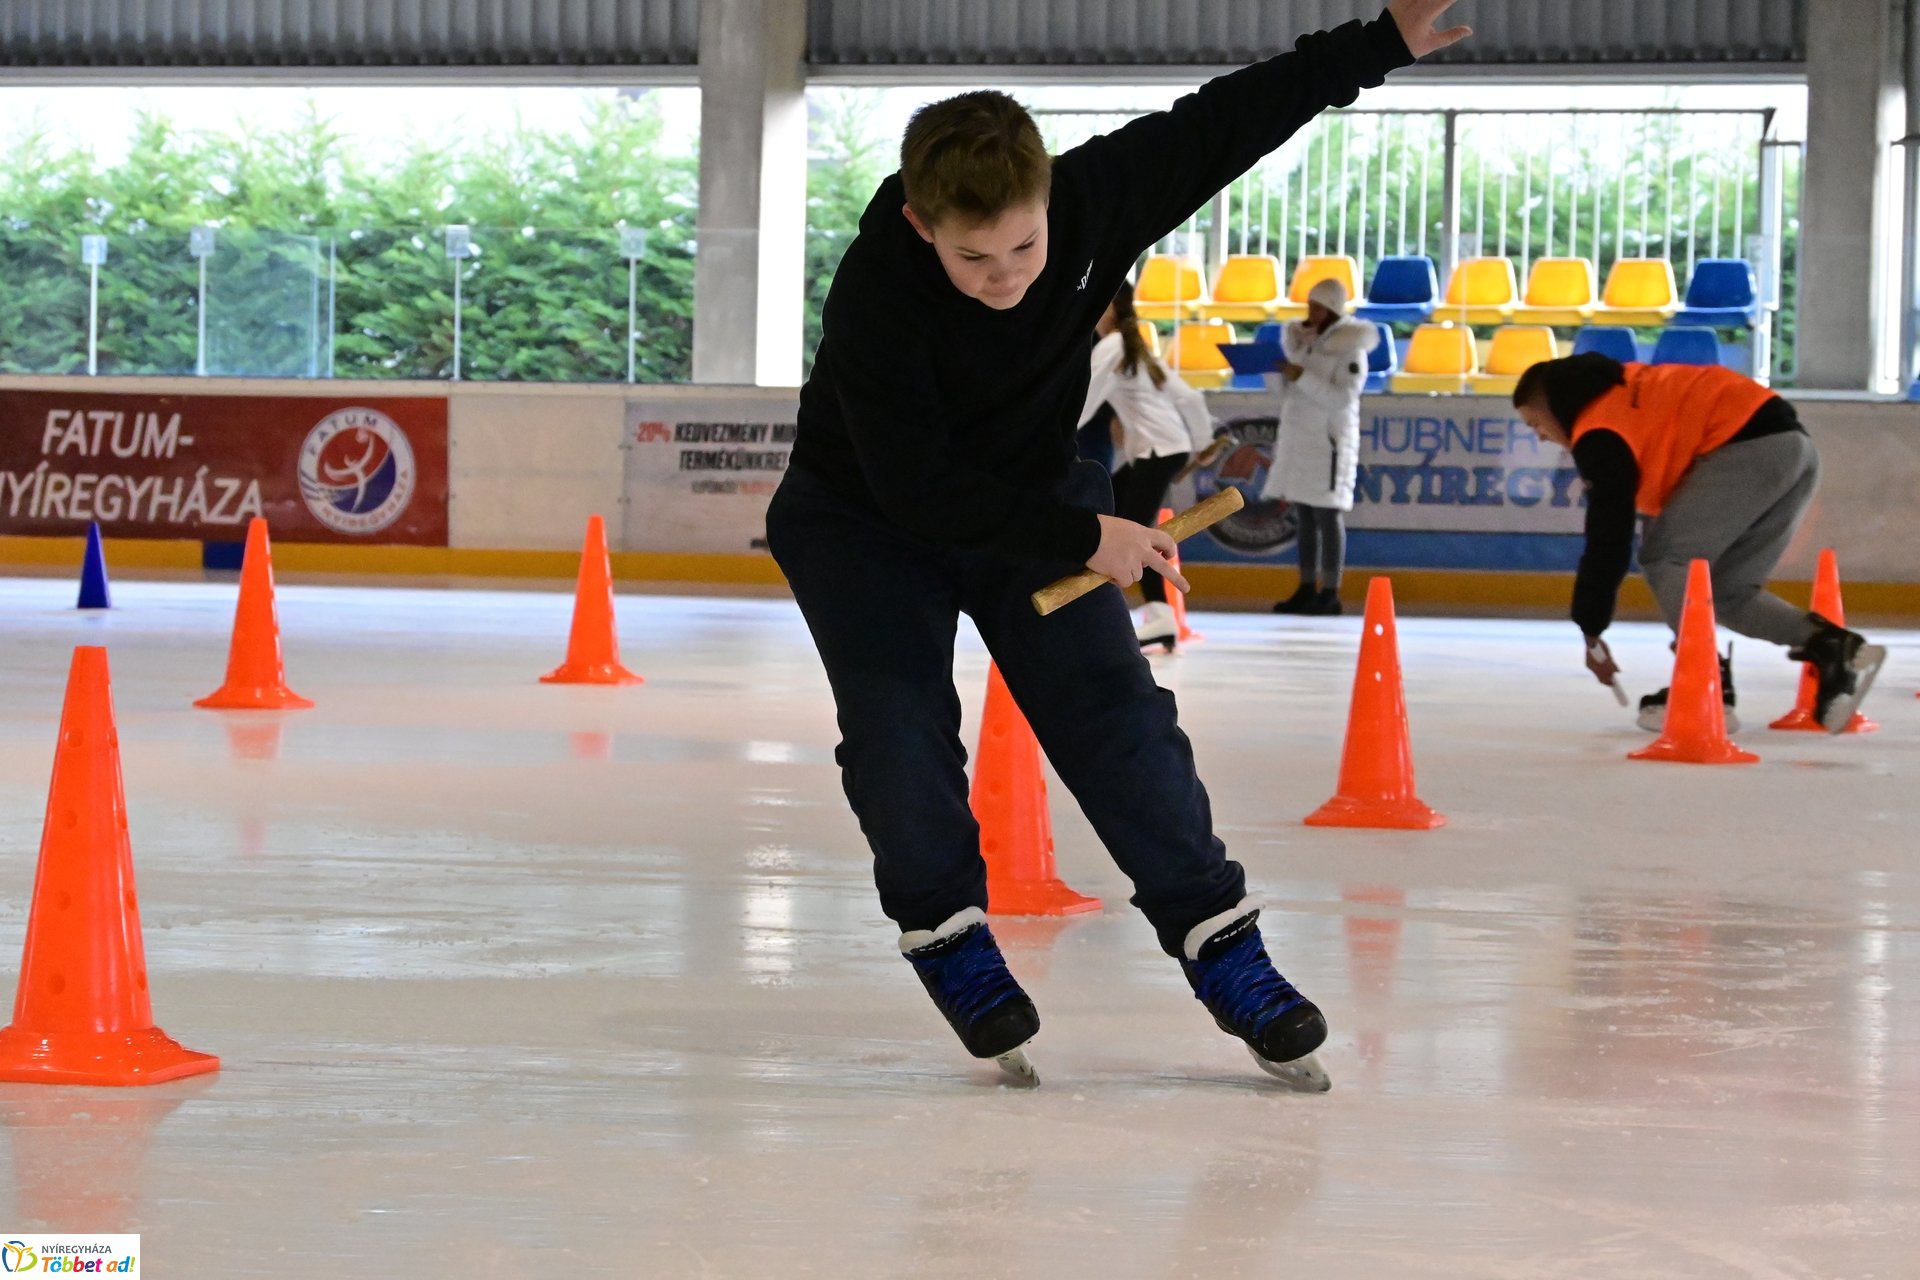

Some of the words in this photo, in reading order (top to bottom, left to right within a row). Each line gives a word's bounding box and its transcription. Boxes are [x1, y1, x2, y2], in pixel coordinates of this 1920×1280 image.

[41, 410, 194, 458] FATUM-
[0, 461, 261, 524] YÍREGYHÁZA
[1354, 447, 1587, 505] NYÍREGY
